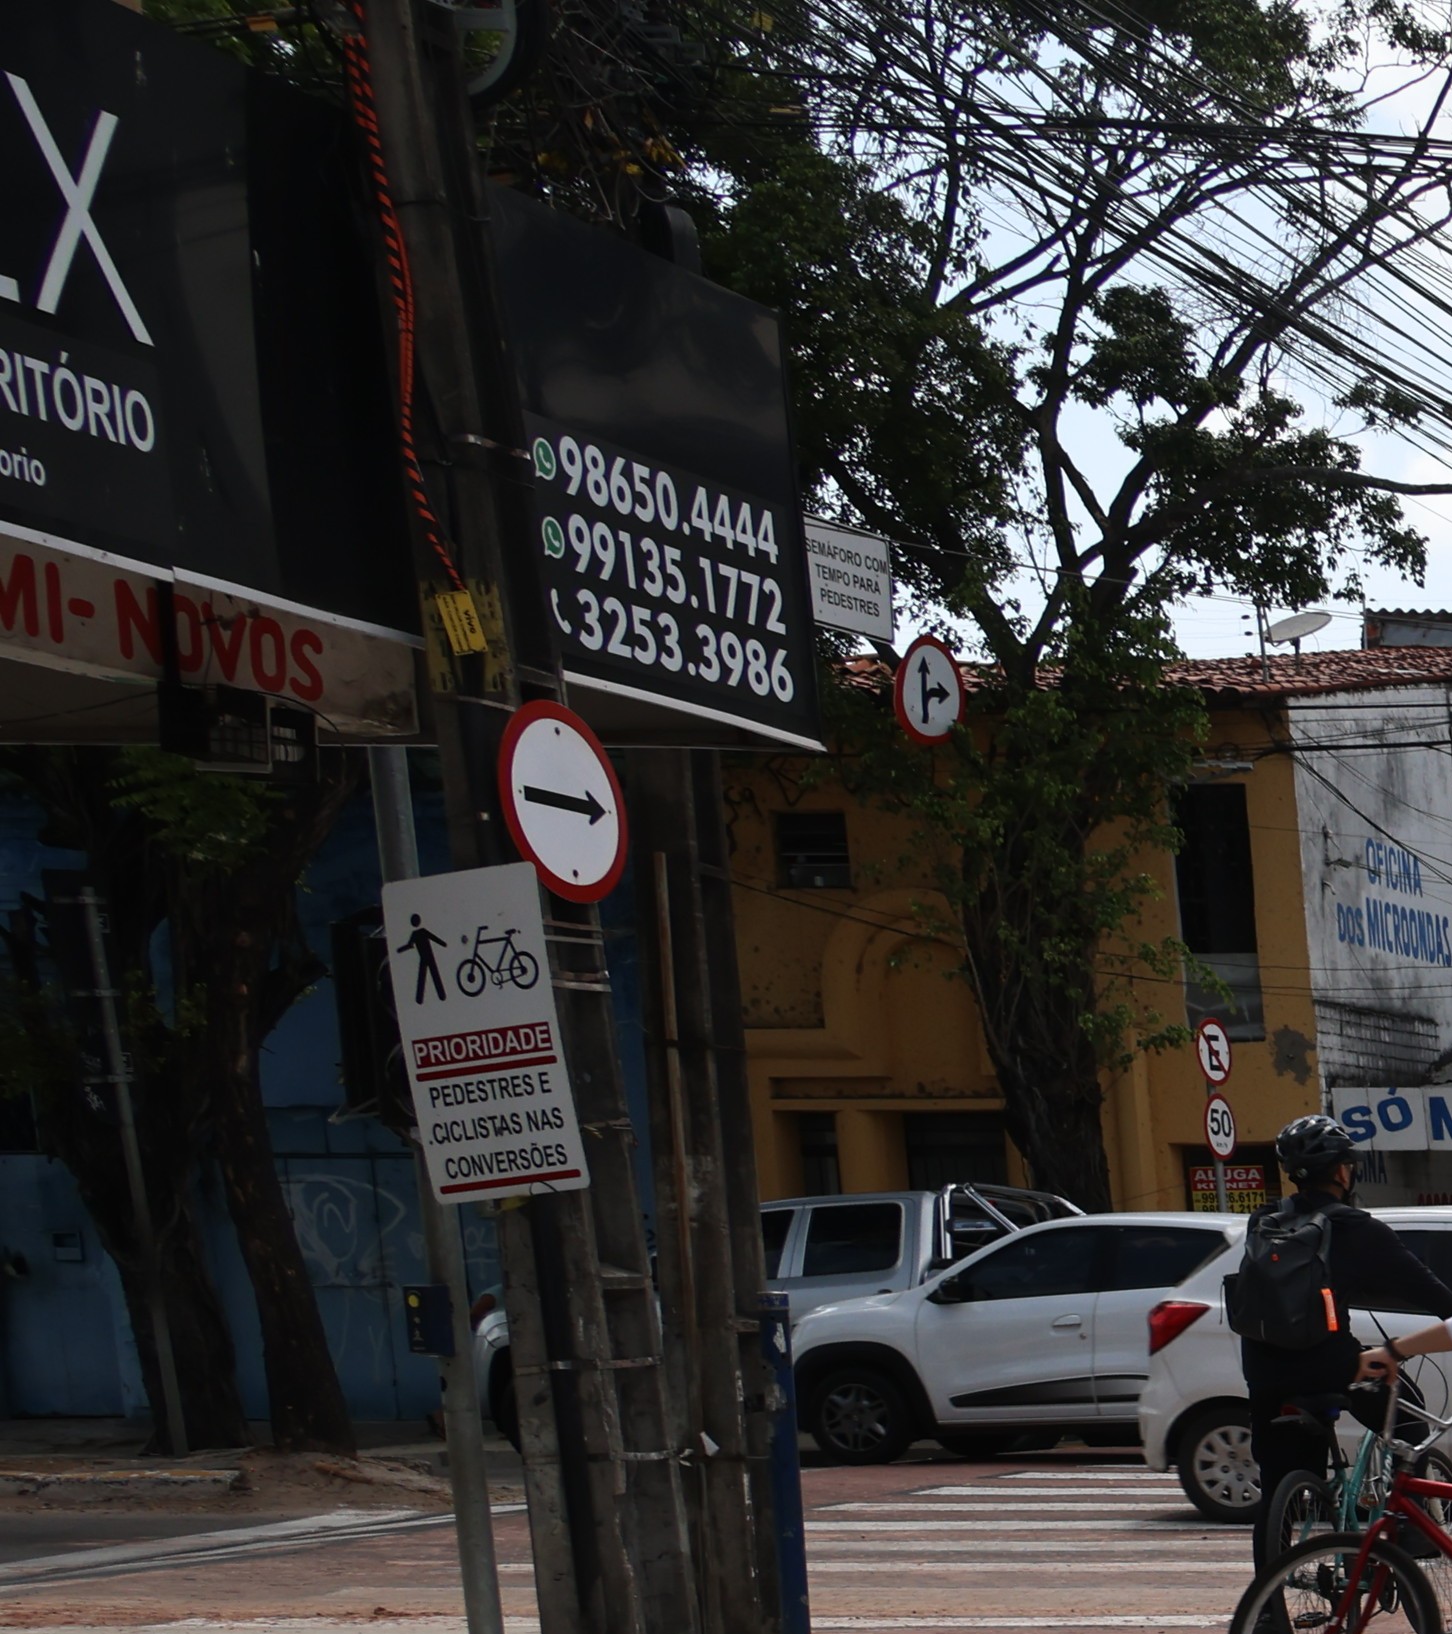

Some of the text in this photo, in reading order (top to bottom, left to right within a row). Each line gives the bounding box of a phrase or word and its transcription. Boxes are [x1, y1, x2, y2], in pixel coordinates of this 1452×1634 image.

[559, 435, 778, 564] 98650.4444
[568, 514, 786, 635] 99135.1772
[814, 565, 850, 588] TEMPO
[864, 557, 888, 575] COM
[820, 587, 880, 618] PEDESTRES
[114, 578, 324, 702] NOVOS
[576, 588, 794, 703] 3253.3986
[1366, 838, 1422, 896] OFICINA
[1337, 896, 1452, 968] DOS MICROONDAS
[414, 1025, 552, 1065] PRIORIDADE
[1207, 1034, 1222, 1072] E
[429, 1072, 552, 1109] PEDESTRES E
[432, 1107, 564, 1145] CICLISTAS NAS
[1210, 1107, 1232, 1138] 50
[1341, 1088, 1413, 1144] SÓ
[445, 1143, 568, 1179] CONVERSÕES
[1197, 1181, 1260, 1190] KINET
